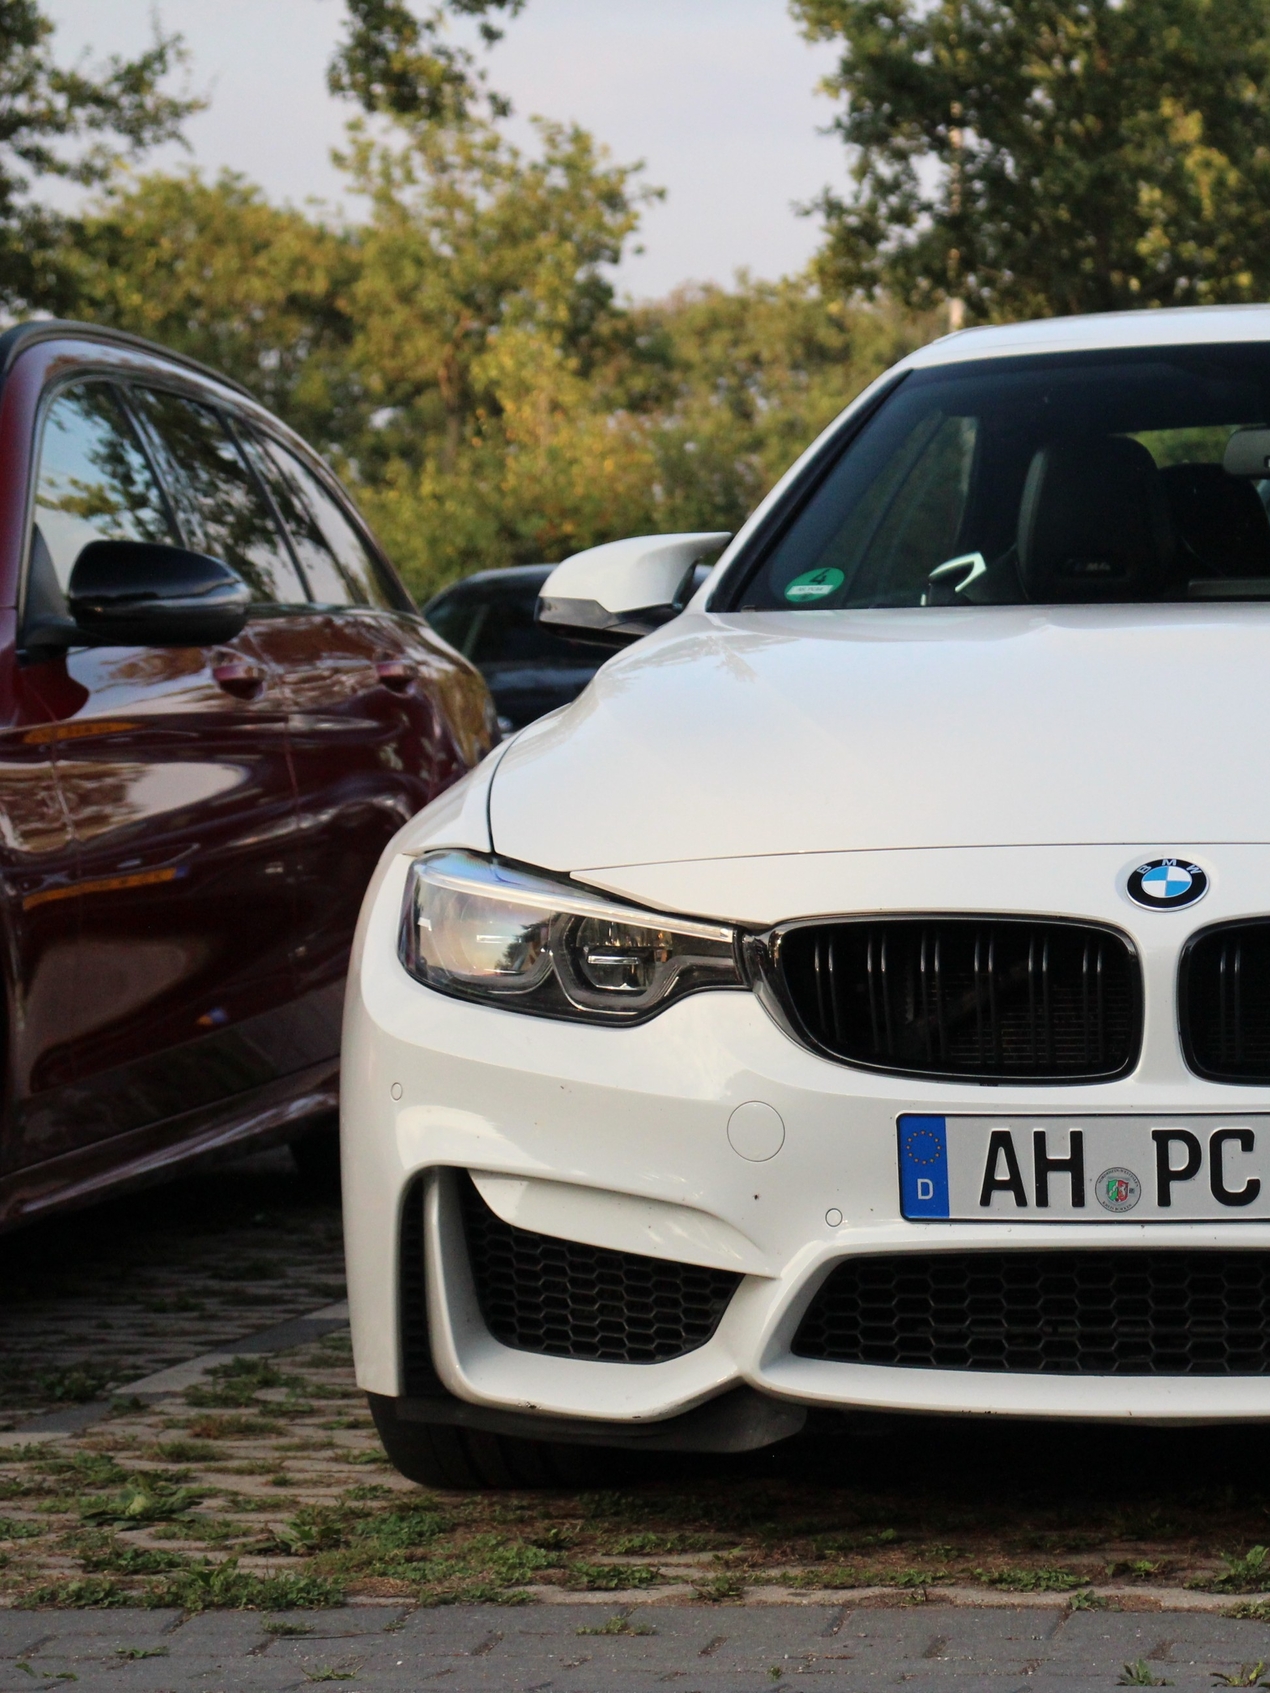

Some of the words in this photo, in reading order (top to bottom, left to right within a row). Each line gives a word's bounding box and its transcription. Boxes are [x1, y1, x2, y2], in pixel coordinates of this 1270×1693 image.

[809, 568, 831, 585] 4
[1136, 859, 1202, 874] BMW
[979, 1130, 1085, 1208] AH
[1151, 1128, 1261, 1208] PC
[917, 1178, 934, 1200] D
